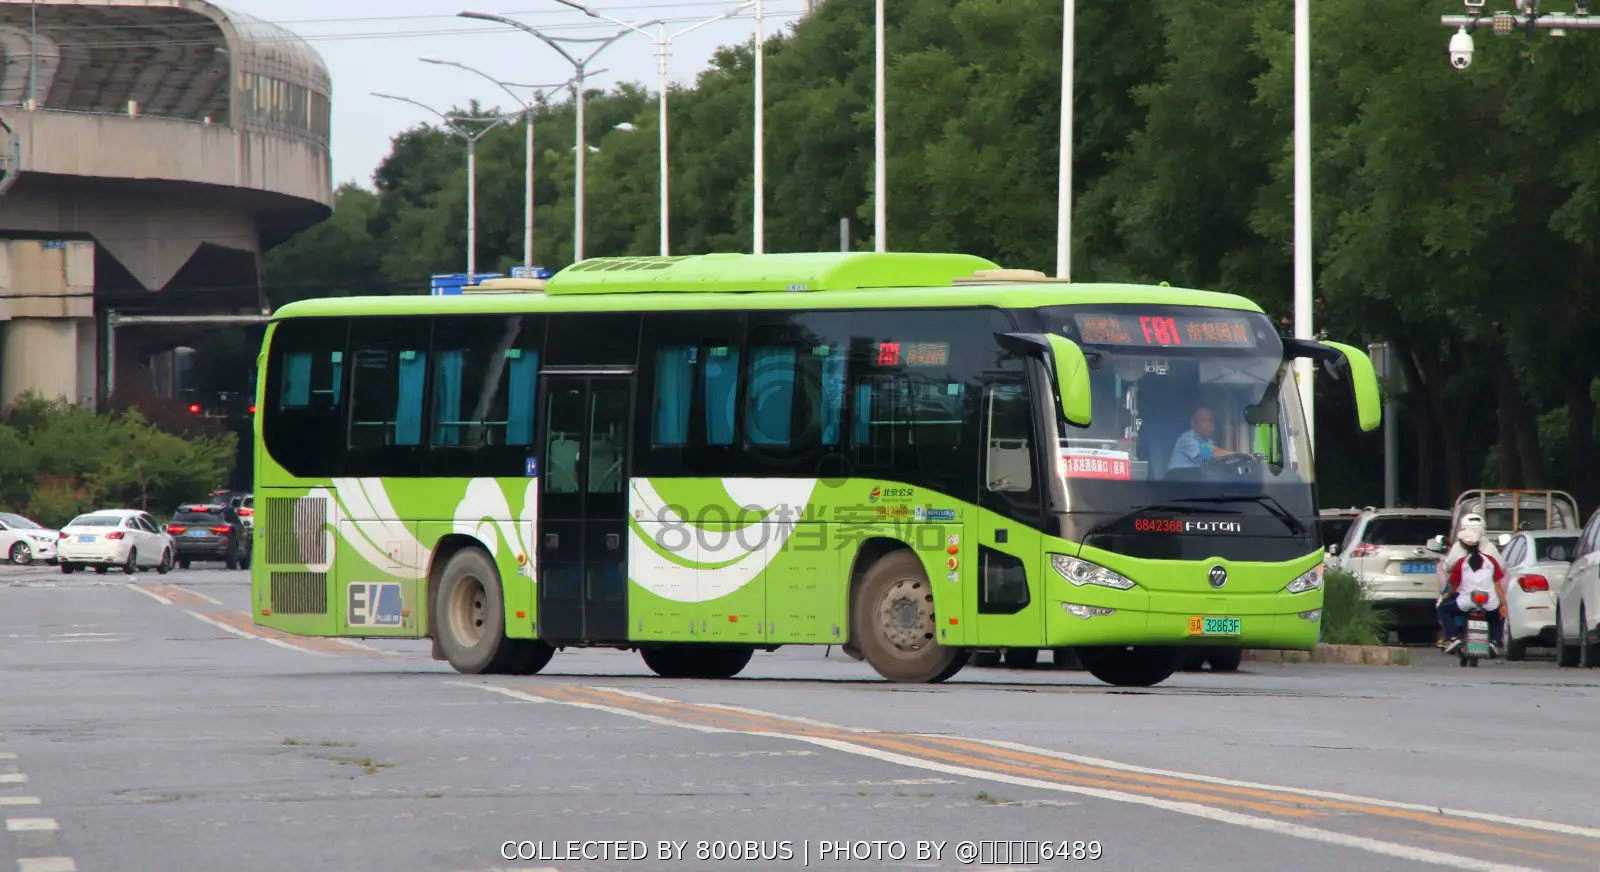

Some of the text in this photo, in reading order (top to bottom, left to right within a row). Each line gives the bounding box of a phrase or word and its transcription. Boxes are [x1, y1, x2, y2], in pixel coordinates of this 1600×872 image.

[1140, 316, 1180, 344] F81
[883, 488, 914, 497] 北京公交
[1135, 519, 1241, 532] 6842368 FOTON
[1205, 618, 1240, 632] 32863F
